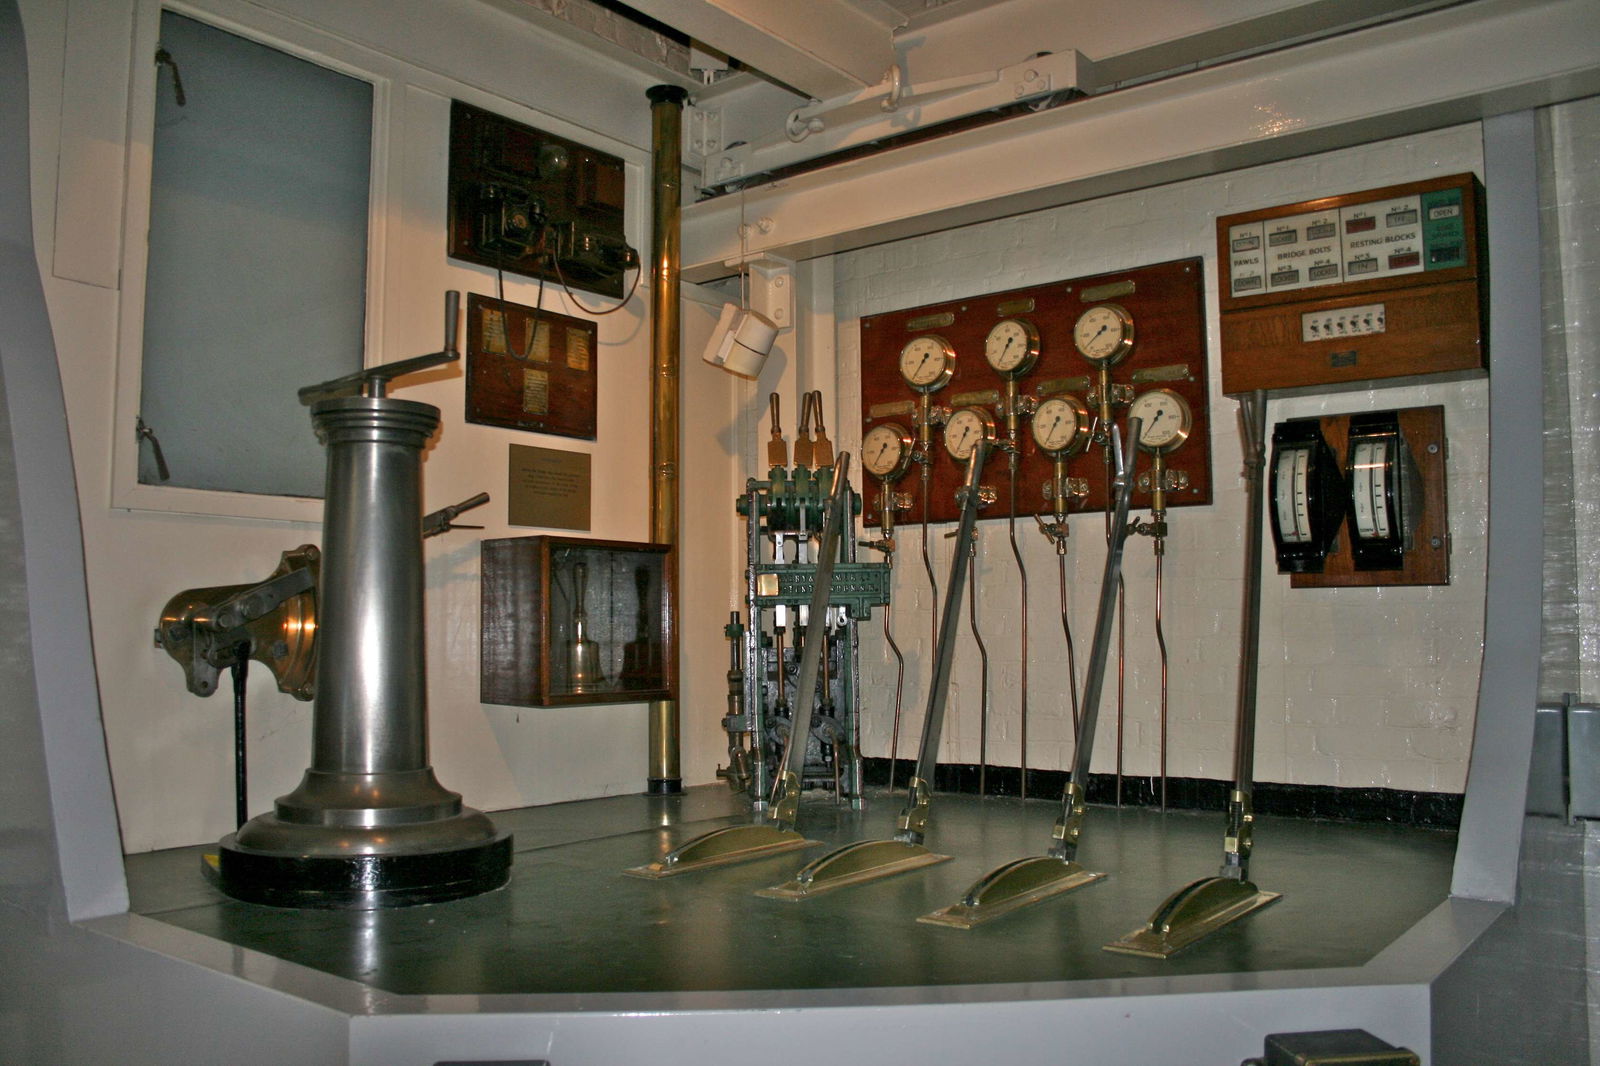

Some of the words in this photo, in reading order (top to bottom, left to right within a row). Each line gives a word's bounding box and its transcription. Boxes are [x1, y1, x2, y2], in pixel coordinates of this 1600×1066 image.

[1433, 207, 1453, 217] OPEN
[1350, 239, 1383, 249] RESTING
[1385, 232, 1416, 243] BLOCKS
[1277, 250, 1305, 260] BRIDGE
[1309, 246, 1332, 255] BOLTS
[1234, 258, 1259, 266] PAWLS
